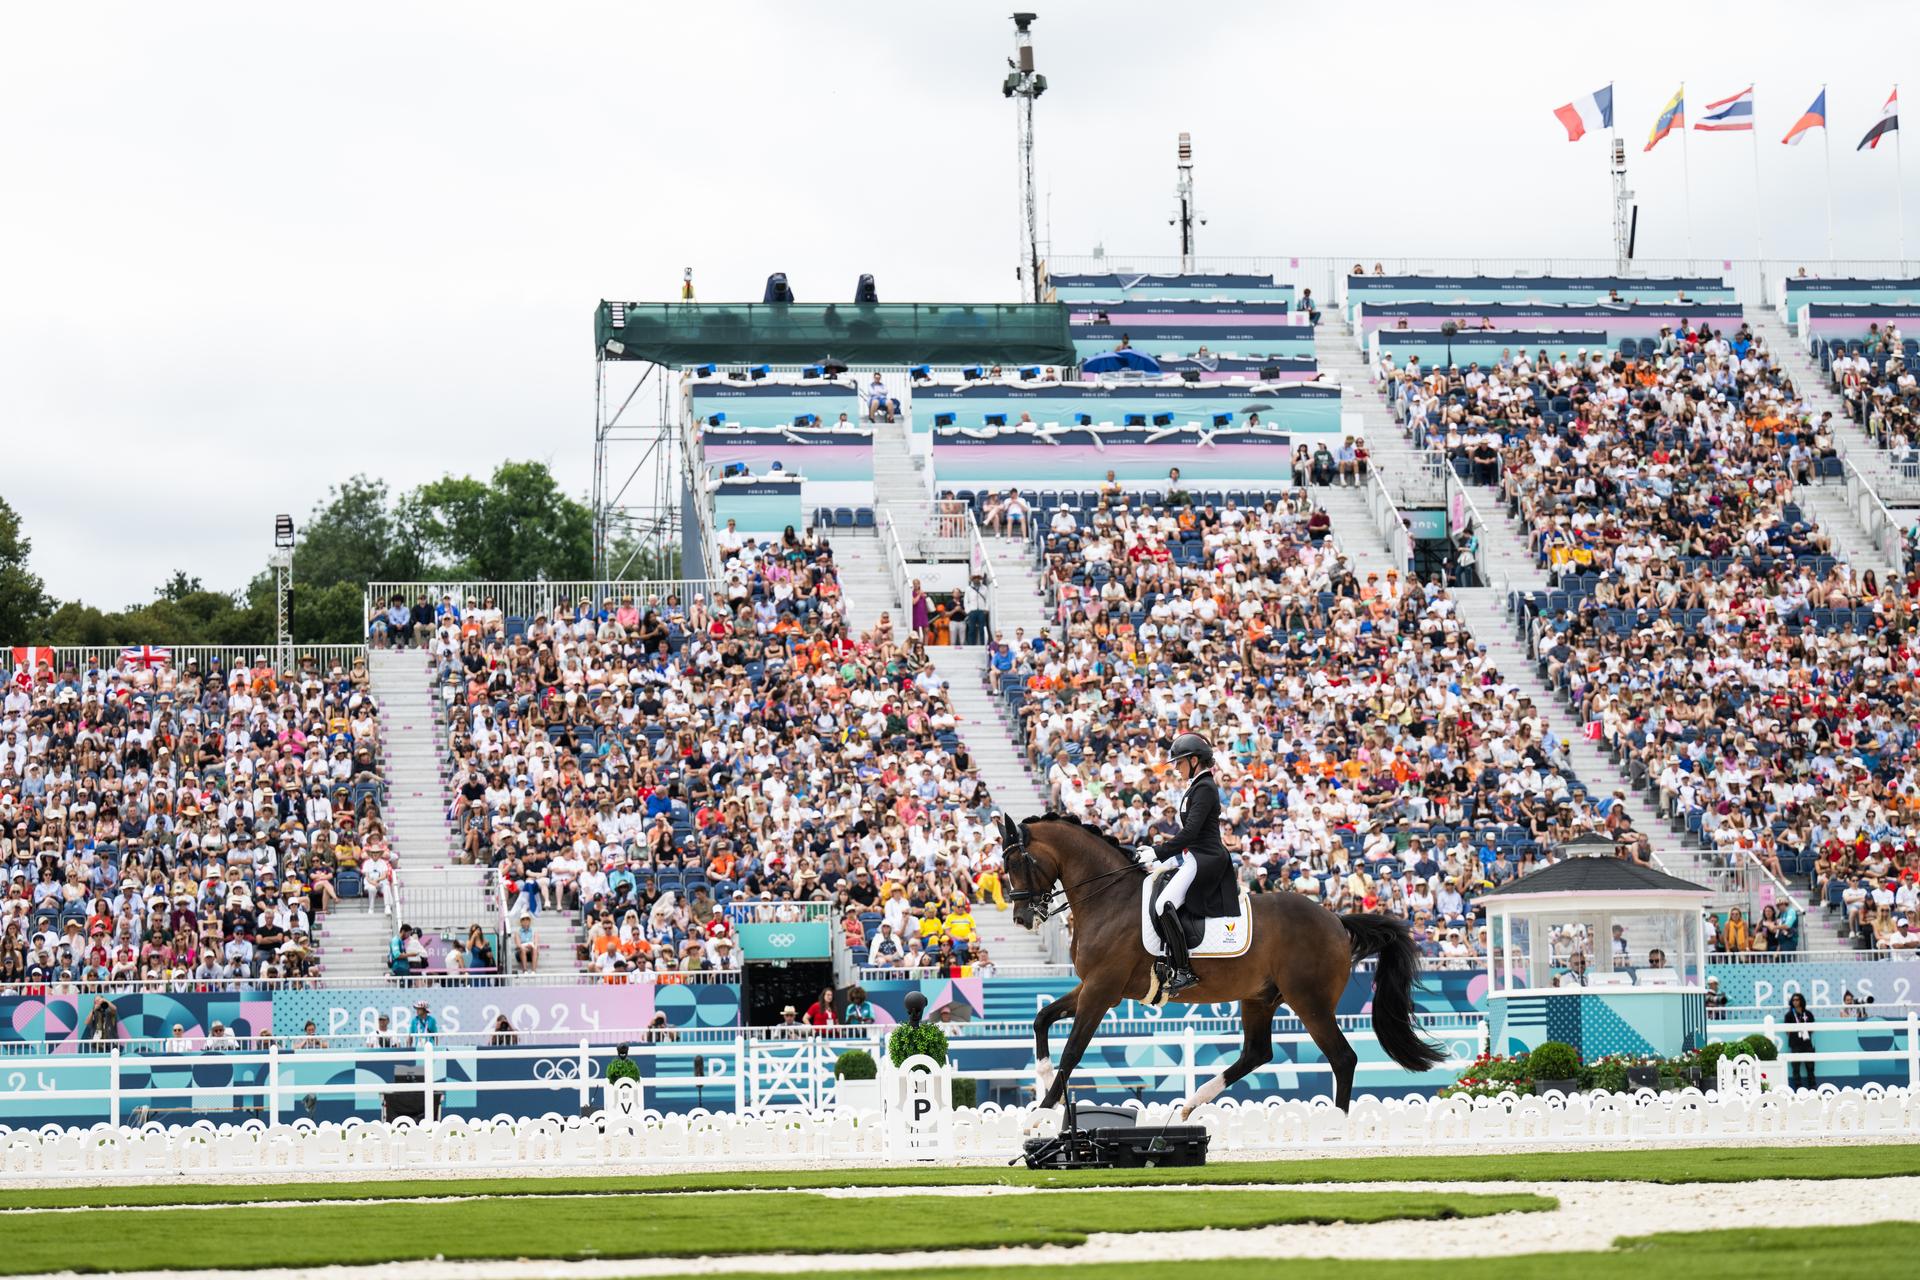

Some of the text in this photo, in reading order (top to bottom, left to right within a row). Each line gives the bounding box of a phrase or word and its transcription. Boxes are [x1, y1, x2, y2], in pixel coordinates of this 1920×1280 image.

[427, 946, 448, 958] RIS
[328, 1002, 599, 1035] PARS 2024
[1740, 1078, 1749, 1091] E
[620, 1101, 632, 1115] V
[914, 1098, 931, 1121] P
